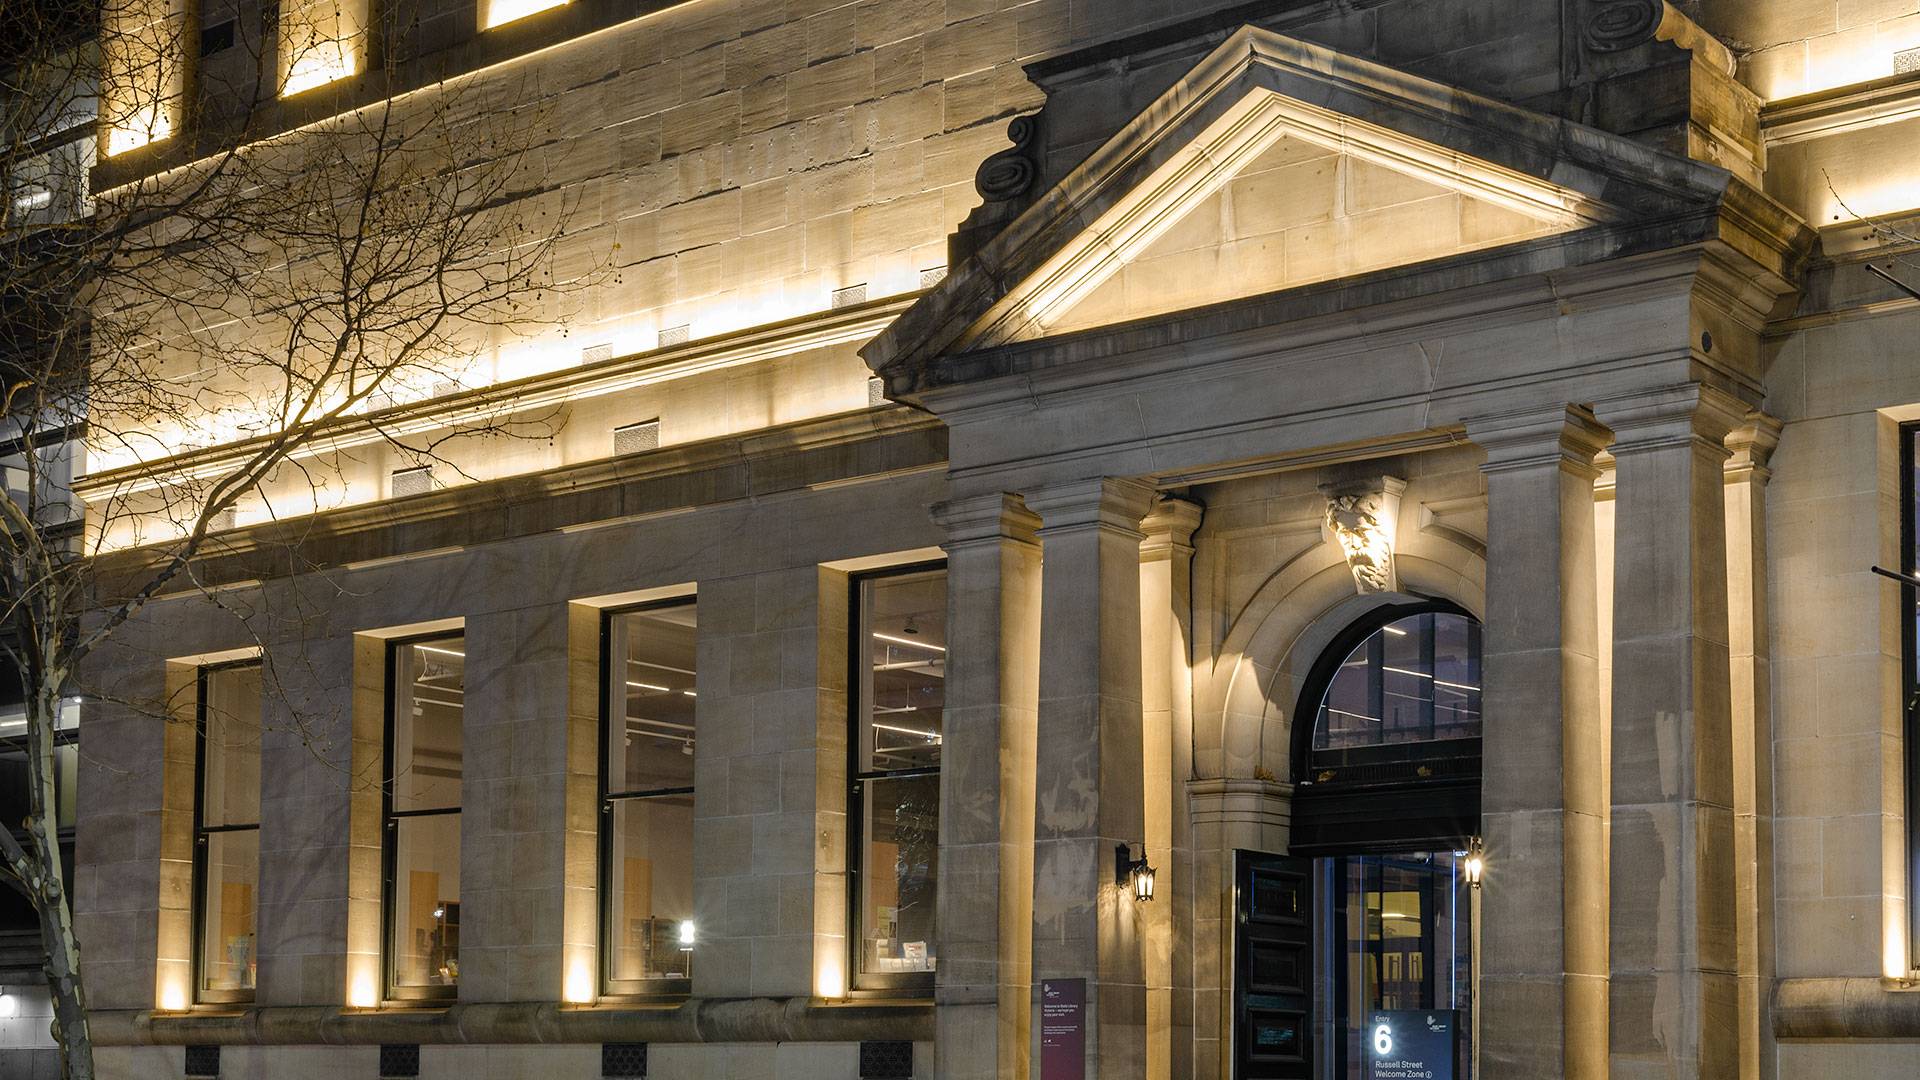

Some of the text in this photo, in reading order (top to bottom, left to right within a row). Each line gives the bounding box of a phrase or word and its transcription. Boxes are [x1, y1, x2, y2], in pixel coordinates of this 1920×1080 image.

[1374, 1024, 1393, 1055] 6
[1375, 1061, 1423, 1069] Russell Street
[1375, 1070, 1424, 1078] Welcome Zone
